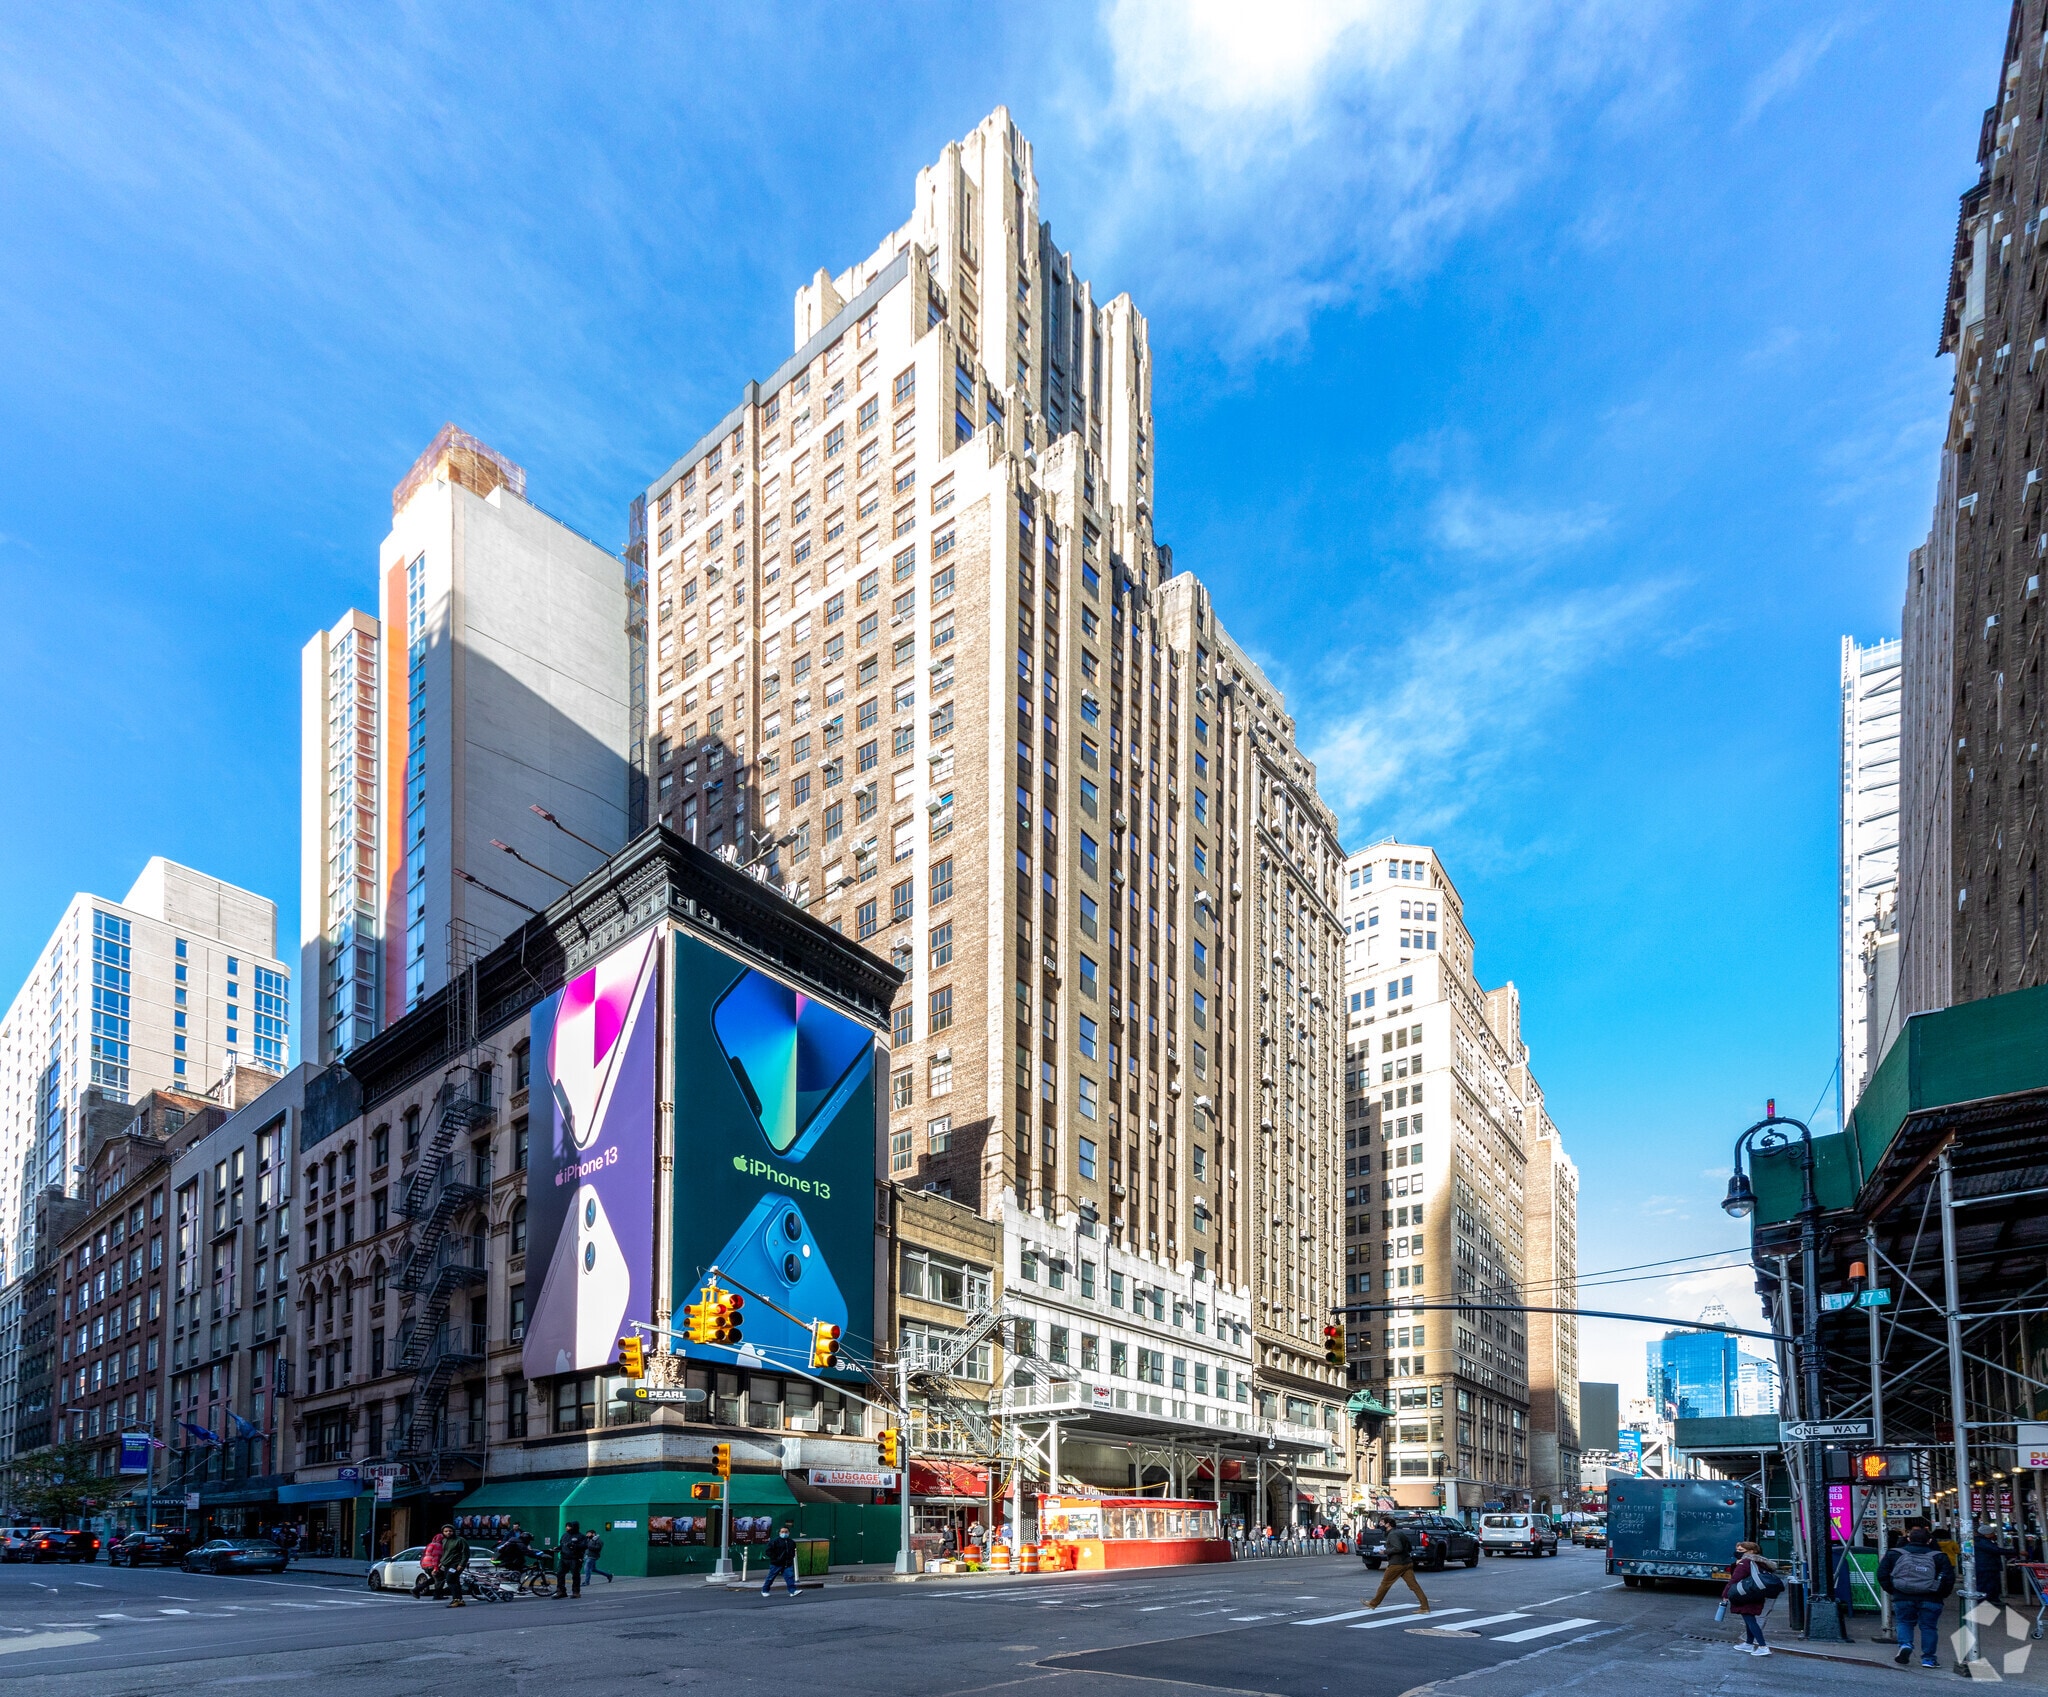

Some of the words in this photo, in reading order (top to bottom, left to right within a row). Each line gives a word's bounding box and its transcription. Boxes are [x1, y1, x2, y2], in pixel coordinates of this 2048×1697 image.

[563, 1156, 604, 1184] iPhone
[603, 1146, 618, 1166] 13
[749, 1158, 811, 1193] iPhone
[812, 1180, 831, 1200] 13
[648, 1390, 687, 1399] PEARL
[1794, 1425, 1820, 1436] ONE
[1833, 1424, 1861, 1434] WAY
[831, 1472, 879, 1481] LUGGAGE
[1058, 1484, 1082, 1495] VENUE
